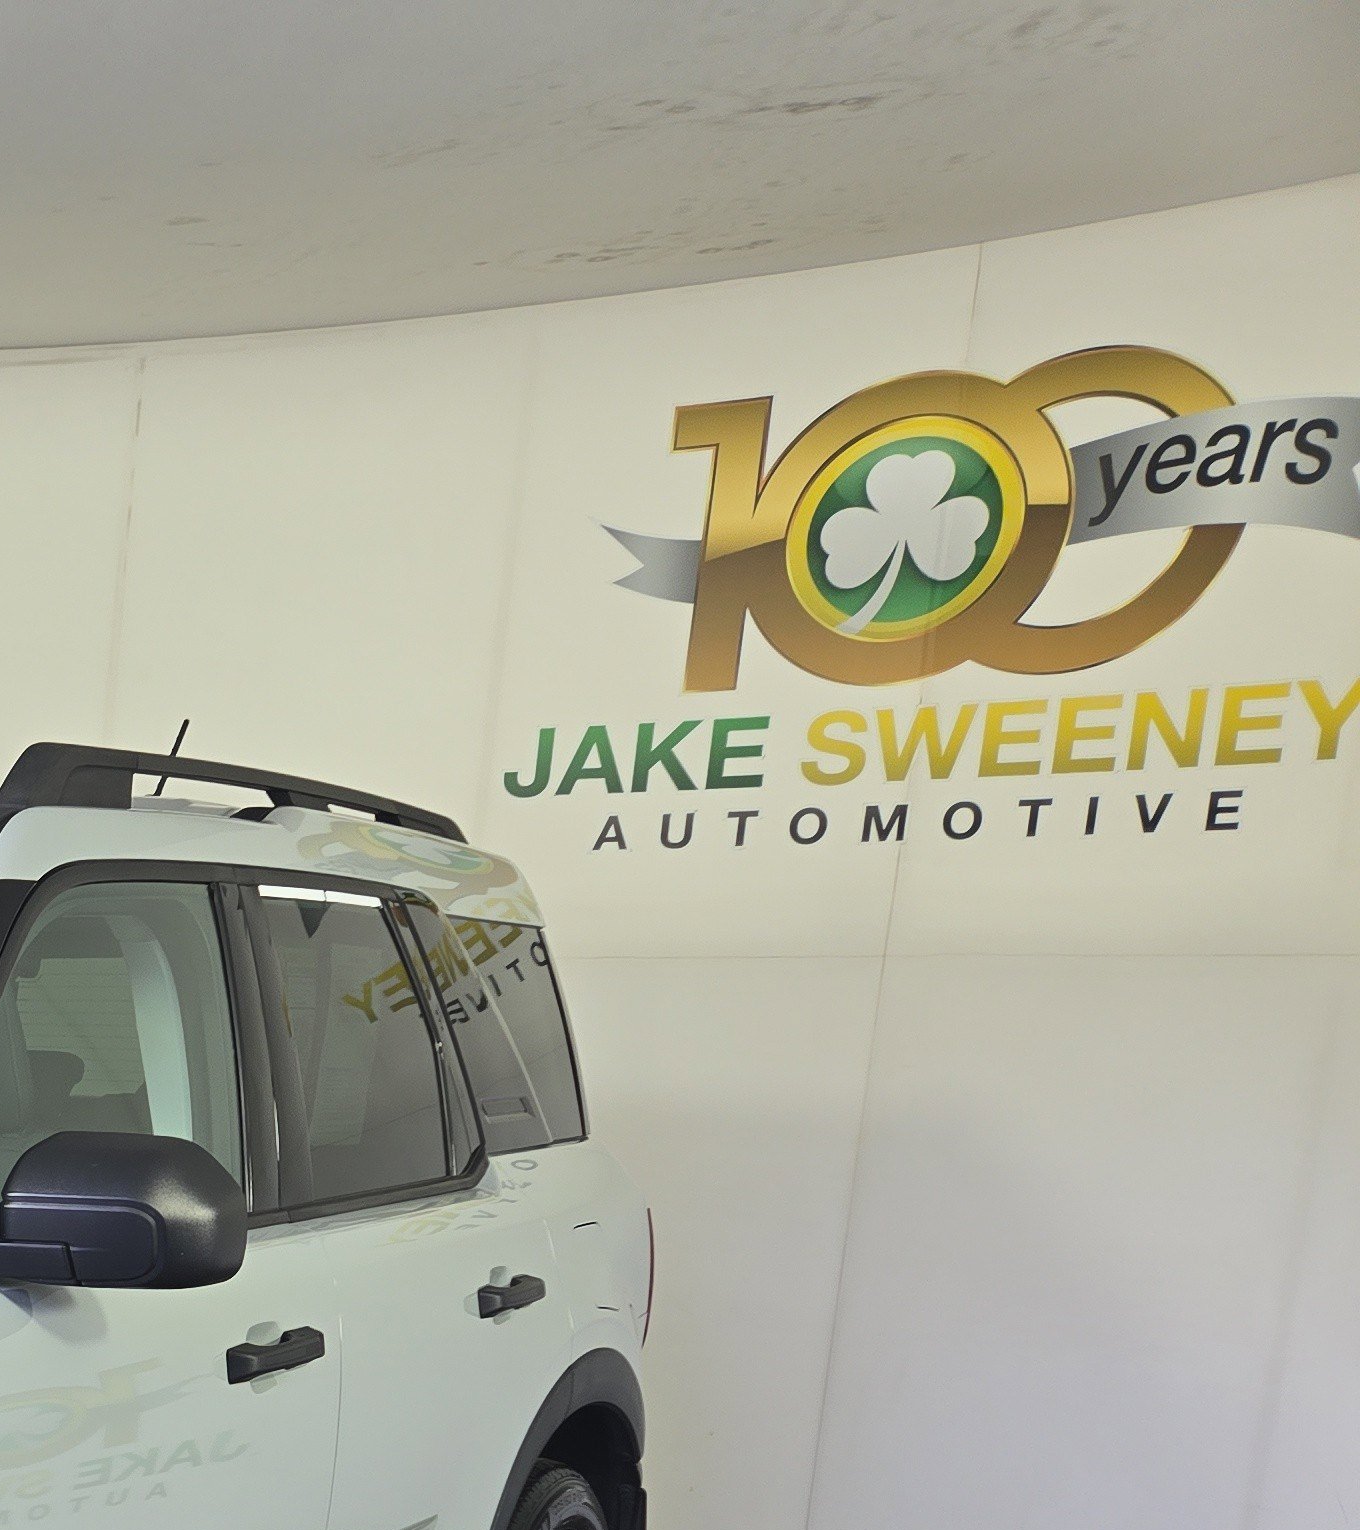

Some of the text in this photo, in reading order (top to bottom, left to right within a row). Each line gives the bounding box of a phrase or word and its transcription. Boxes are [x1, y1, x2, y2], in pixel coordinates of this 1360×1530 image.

[1088, 415, 1340, 528] years
[502, 676, 1360, 799] JAKE SWEENEY
[592, 788, 1245, 852] AUTOMOTIVE
